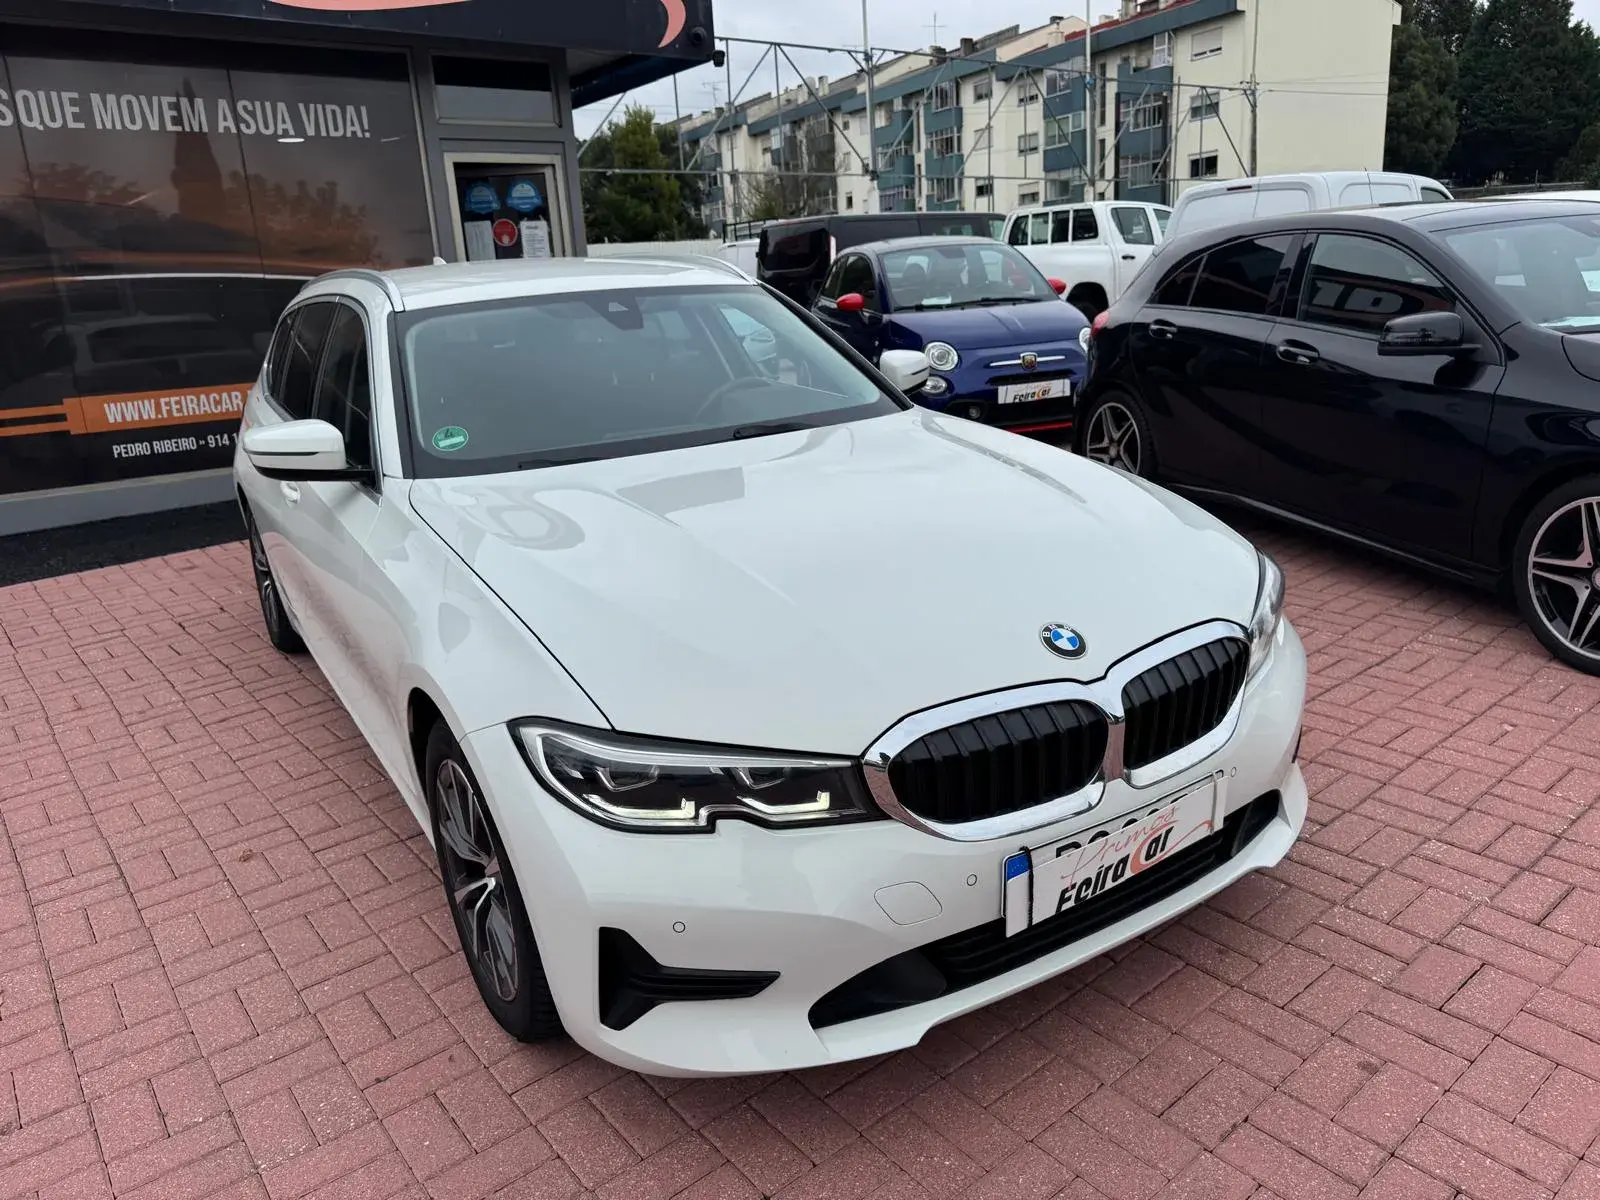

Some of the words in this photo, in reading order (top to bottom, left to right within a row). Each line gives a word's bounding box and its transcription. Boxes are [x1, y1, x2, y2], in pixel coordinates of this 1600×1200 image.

[90, 93, 208, 133] MOVEM
[298, 103, 371, 138] VIDA!
[104, 390, 251, 424] WWW.FEIRACAR
[112, 441, 151, 459] PEDRO
[152, 436, 197, 455] RIBEIRO
[207, 432, 230, 448] 914
